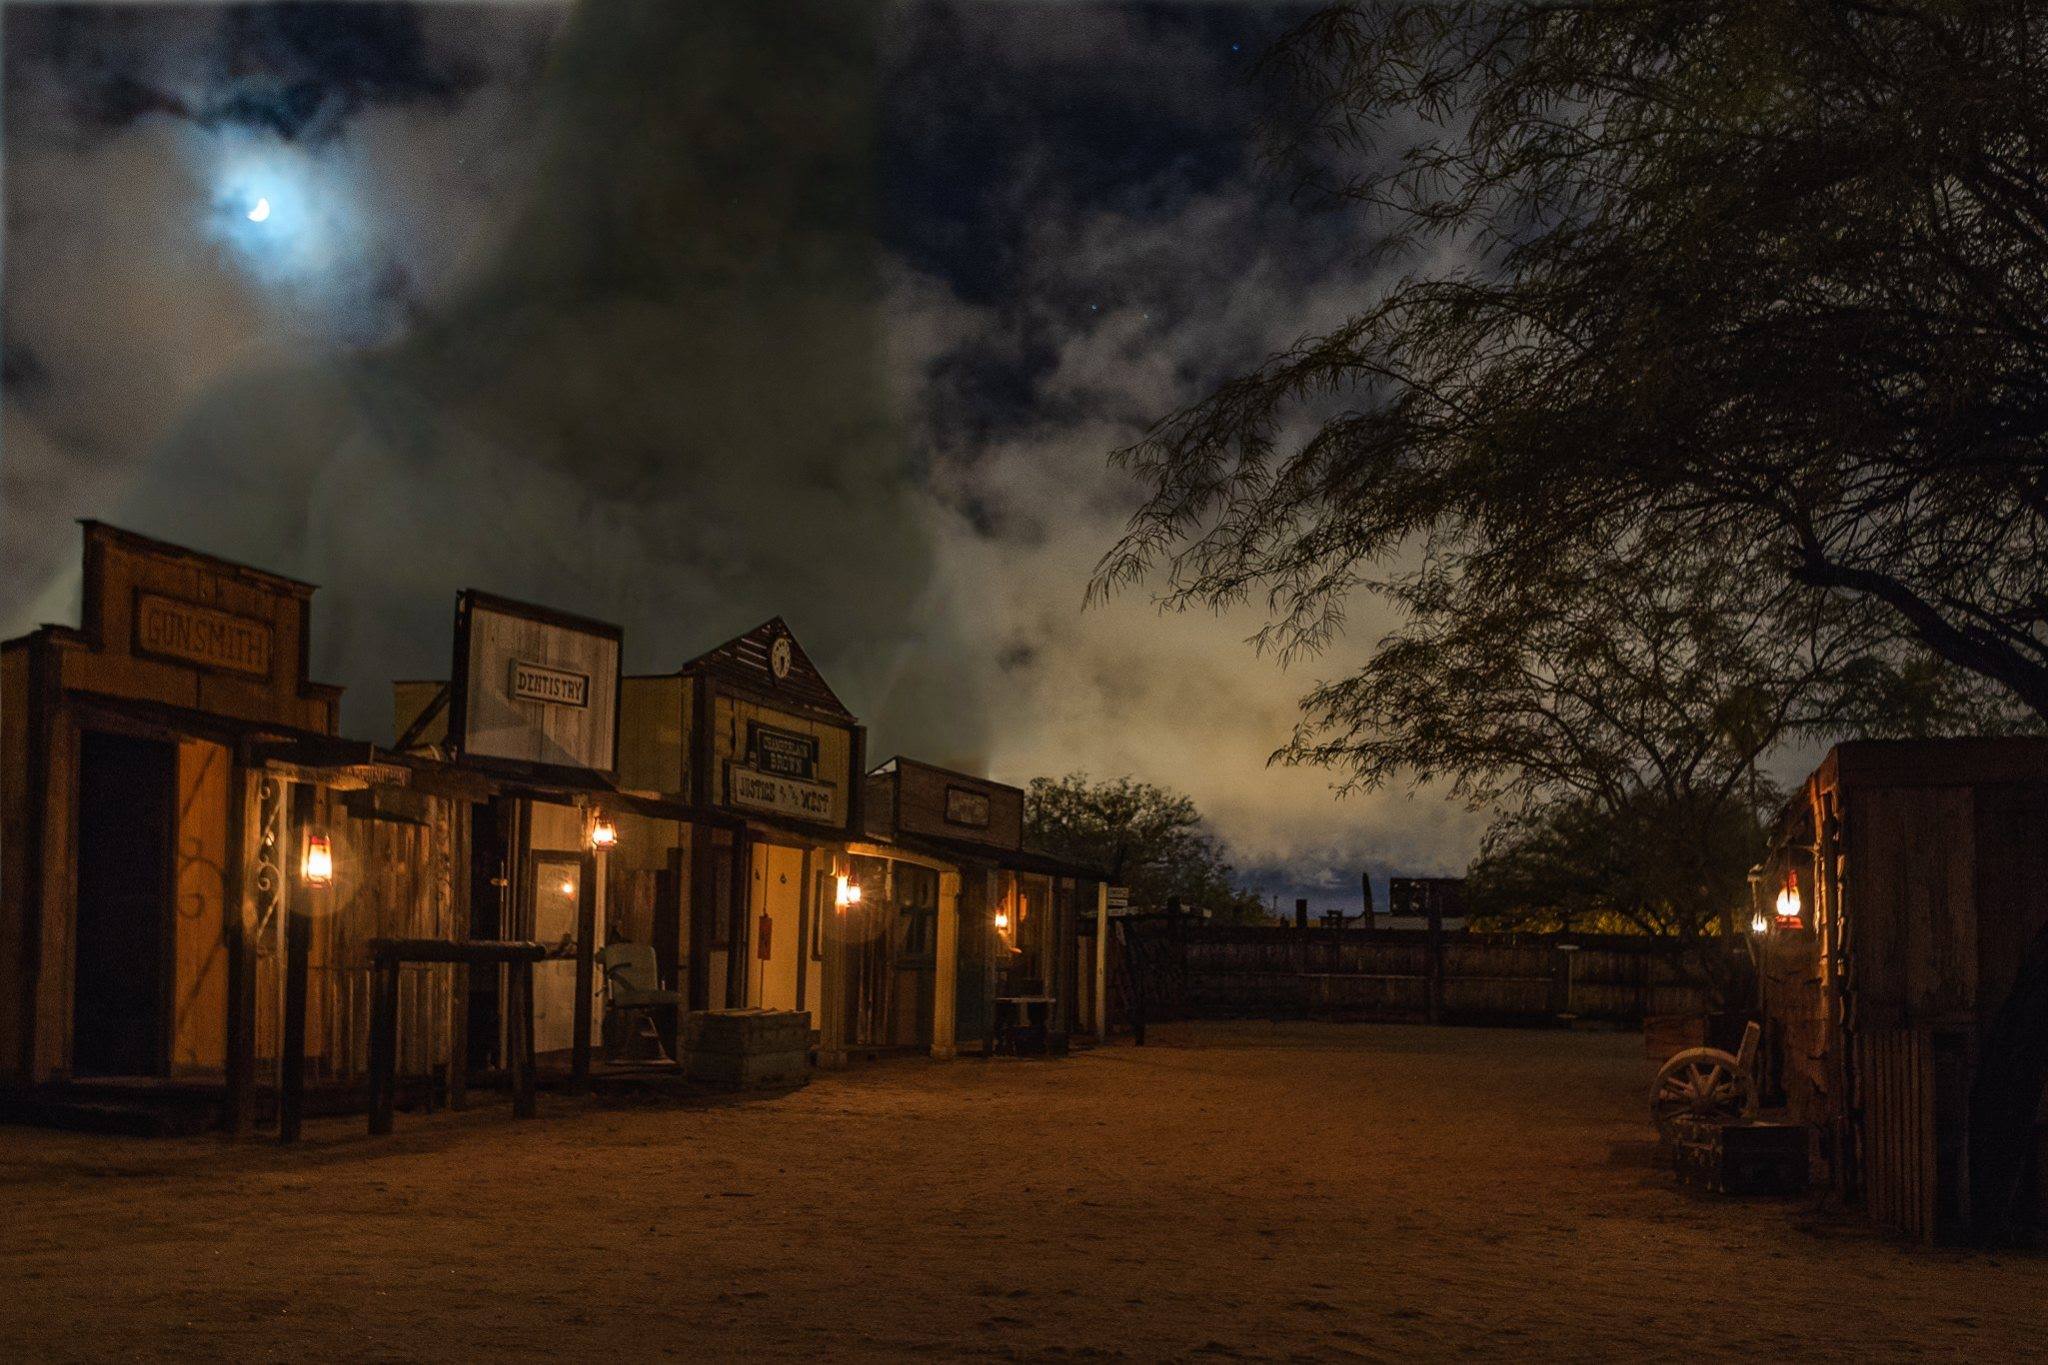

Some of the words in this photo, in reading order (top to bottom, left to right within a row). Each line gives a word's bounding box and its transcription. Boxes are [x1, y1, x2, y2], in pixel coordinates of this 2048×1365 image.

[148, 607, 264, 665] GUNSMITH
[518, 672, 581, 700] DENTISTRY
[801, 790, 828, 812] WEST
